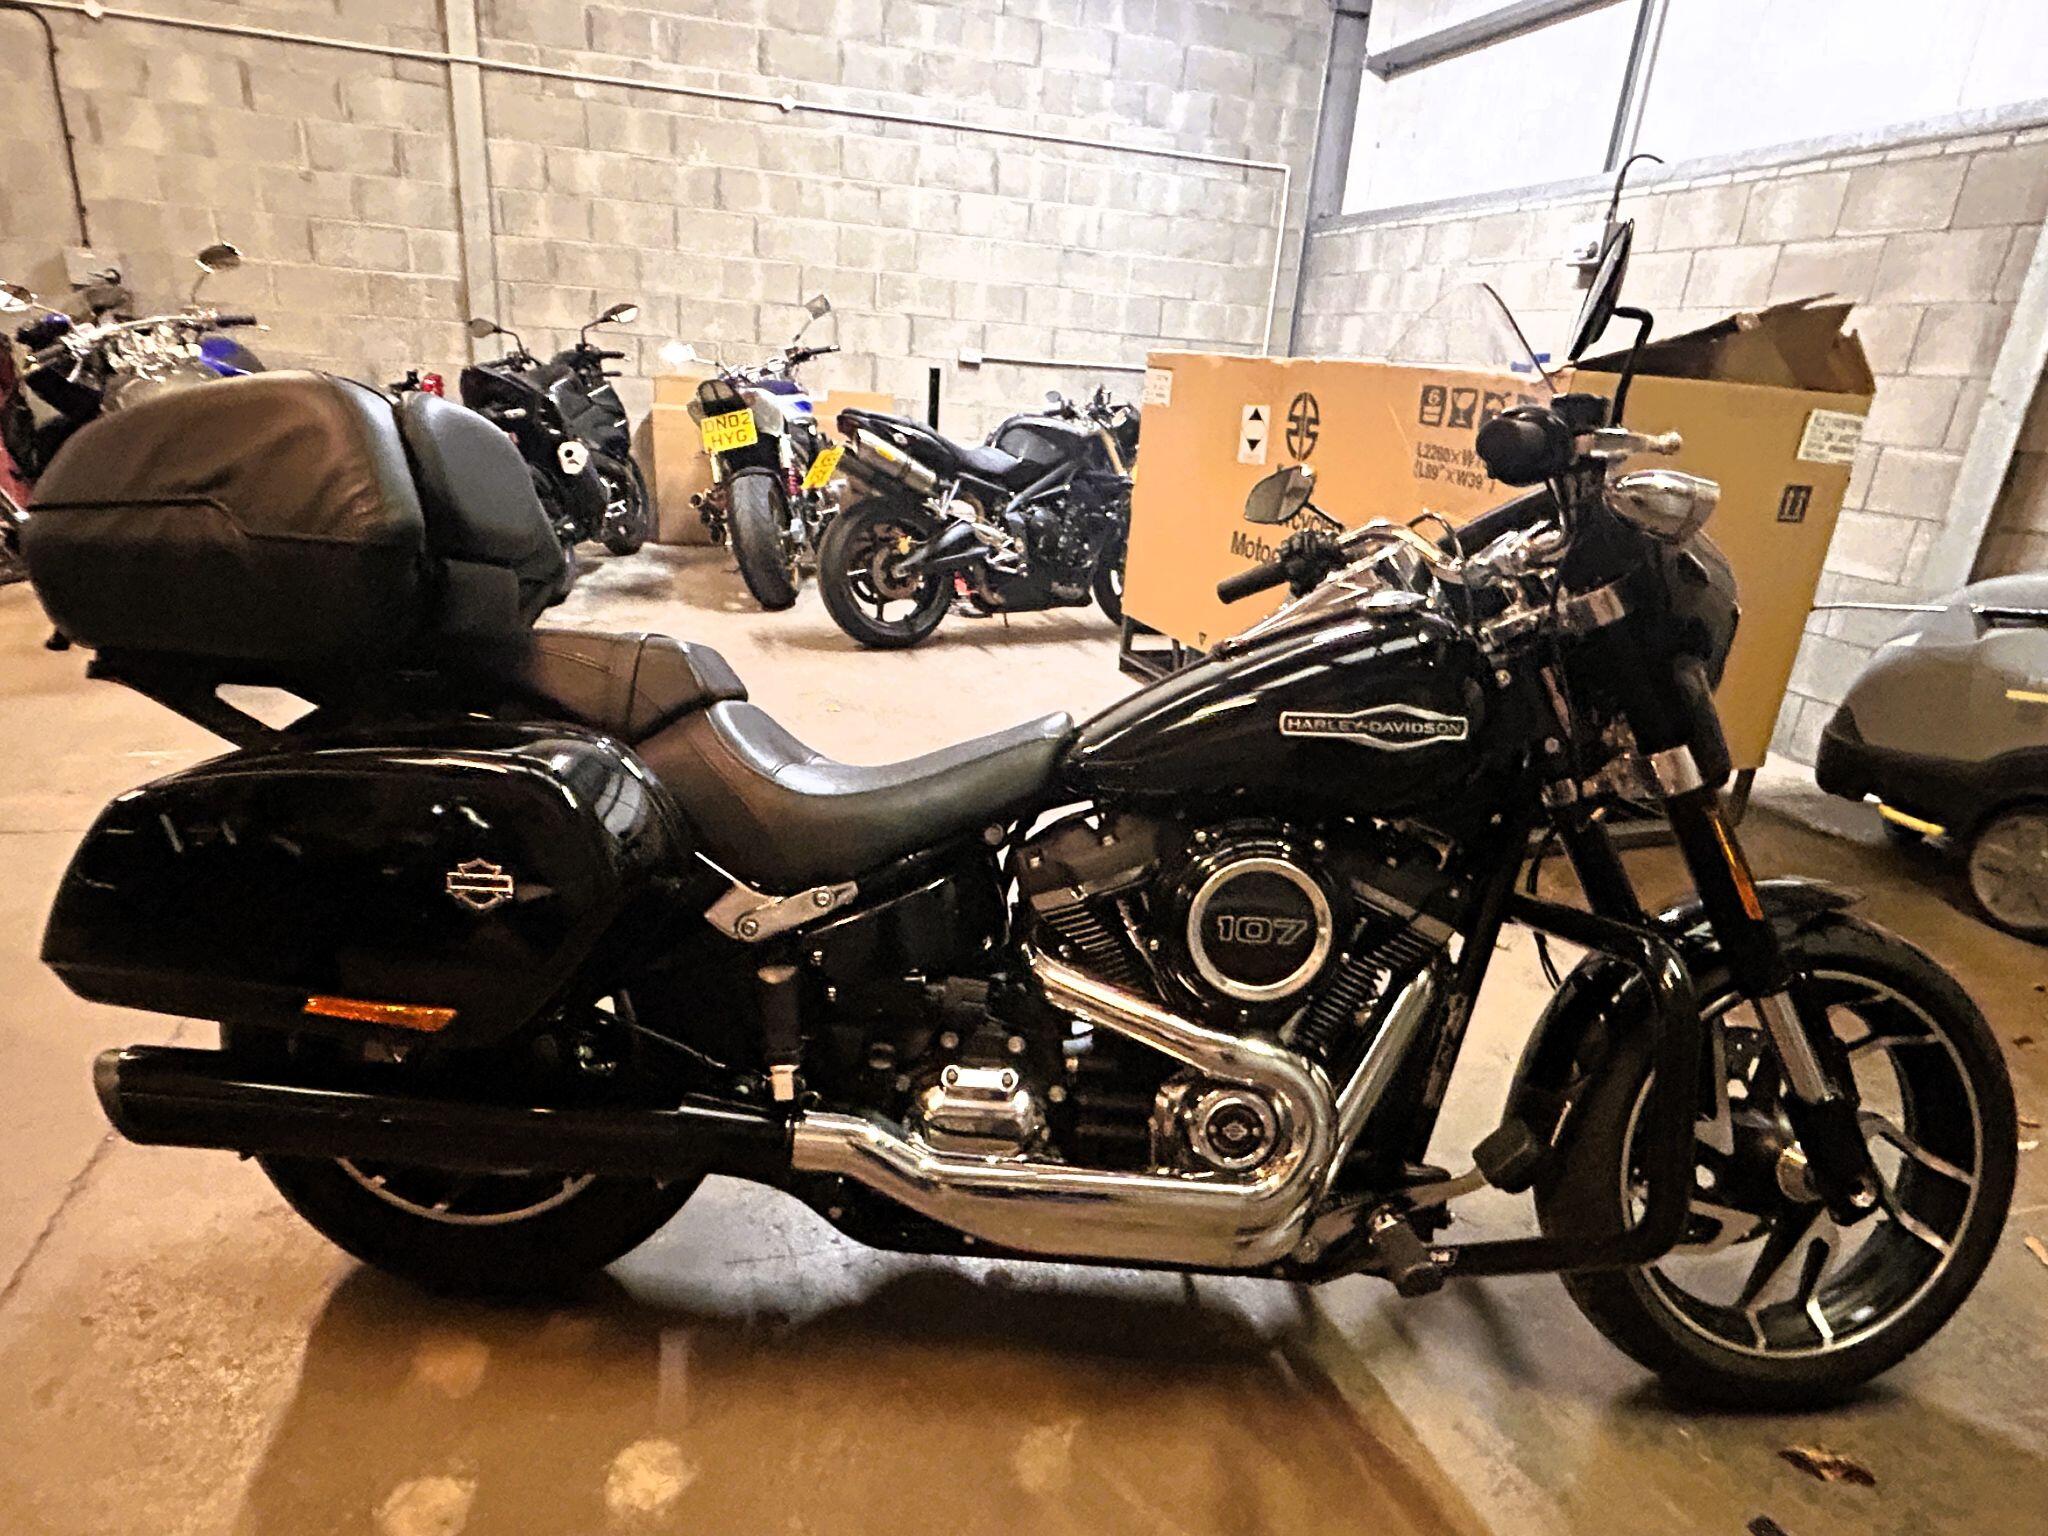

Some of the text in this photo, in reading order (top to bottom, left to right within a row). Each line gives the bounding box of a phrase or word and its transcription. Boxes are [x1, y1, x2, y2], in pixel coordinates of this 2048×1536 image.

[703, 411, 752, 435] DN02
[710, 428, 748, 449] HYG
[1230, 530, 1281, 564] Motoc
[1286, 717, 1462, 735] HARLEY-DAVIDSON
[1217, 914, 1308, 945] 107
